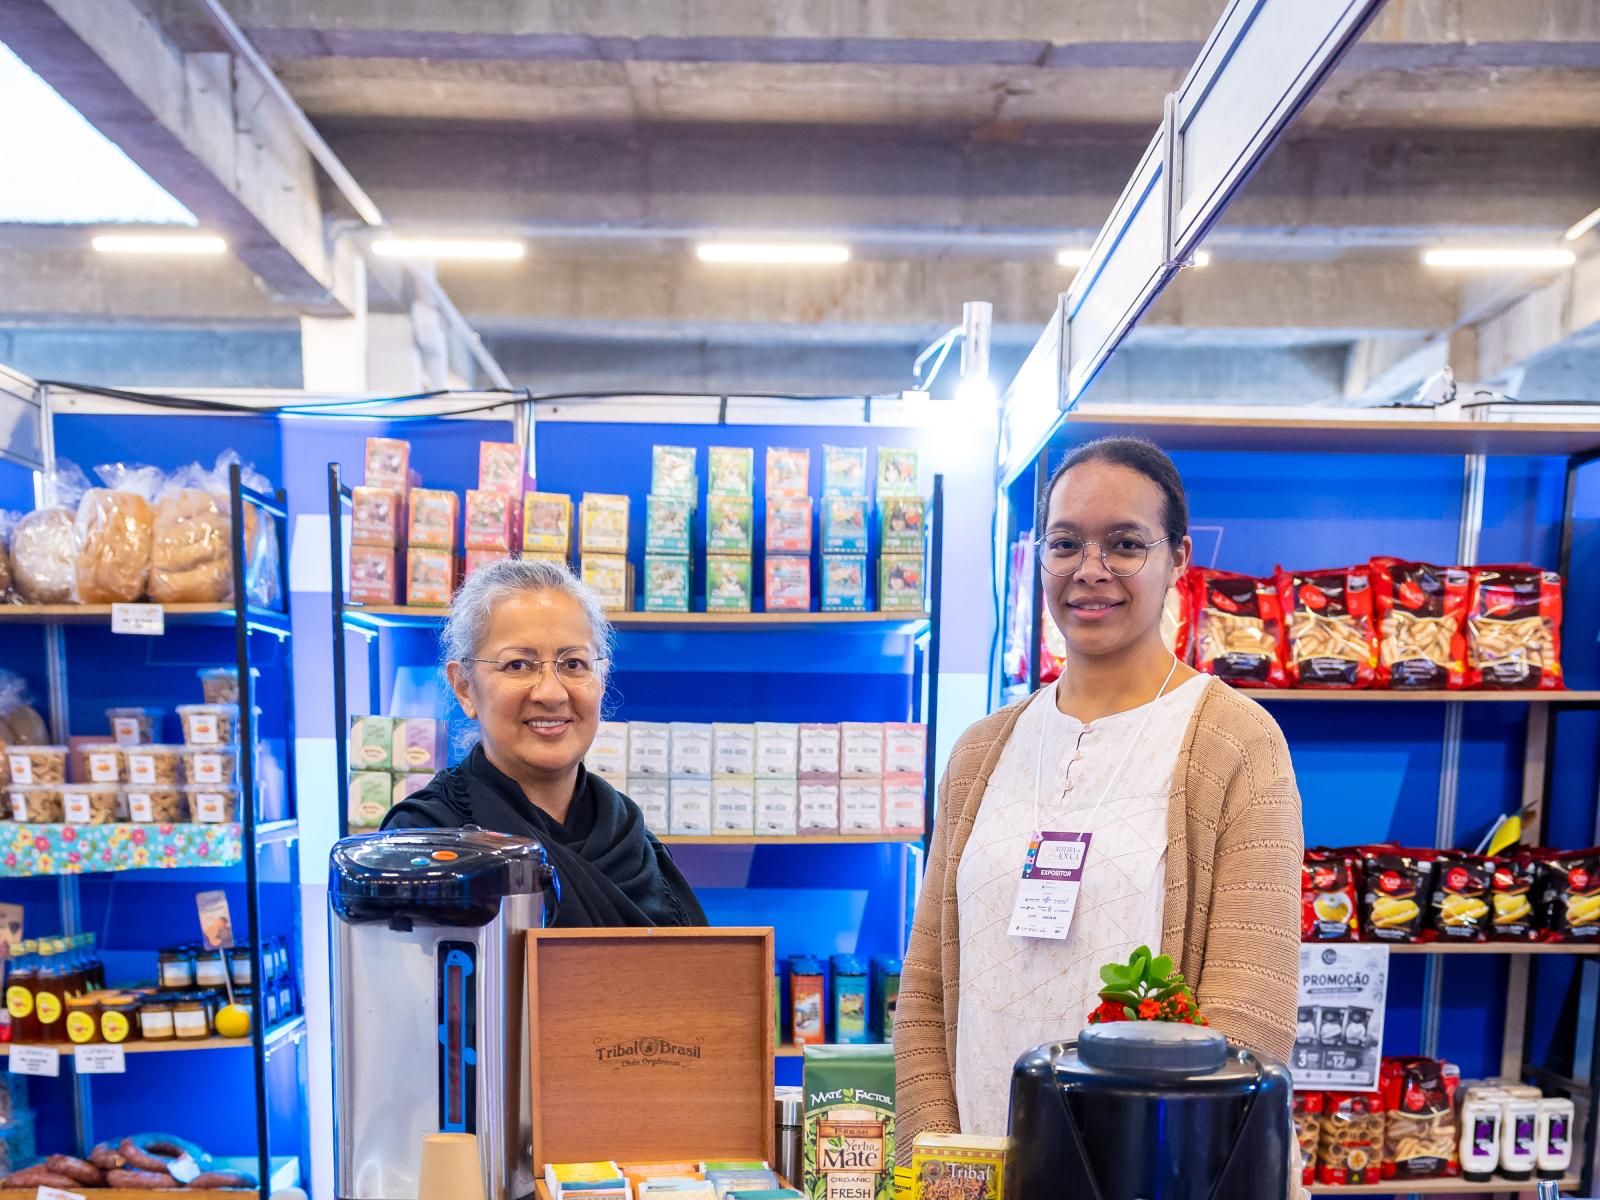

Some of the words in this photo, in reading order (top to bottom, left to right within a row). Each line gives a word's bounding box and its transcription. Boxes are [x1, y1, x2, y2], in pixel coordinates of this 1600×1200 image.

[1040, 869, 1072, 877] EXPOSITOR
[1303, 971, 1370, 986] PROMOÇÃO
[595, 1040, 639, 1061] Tribal
[659, 1039, 701, 1059] Brasil
[810, 1088, 843, 1107] MATÉ
[854, 1088, 893, 1105] FACTOR
[844, 1138, 875, 1152] Yerba
[823, 1146, 880, 1168] Maté
[945, 1162, 991, 1181] Tribal
[831, 1188, 871, 1199] FRESH
